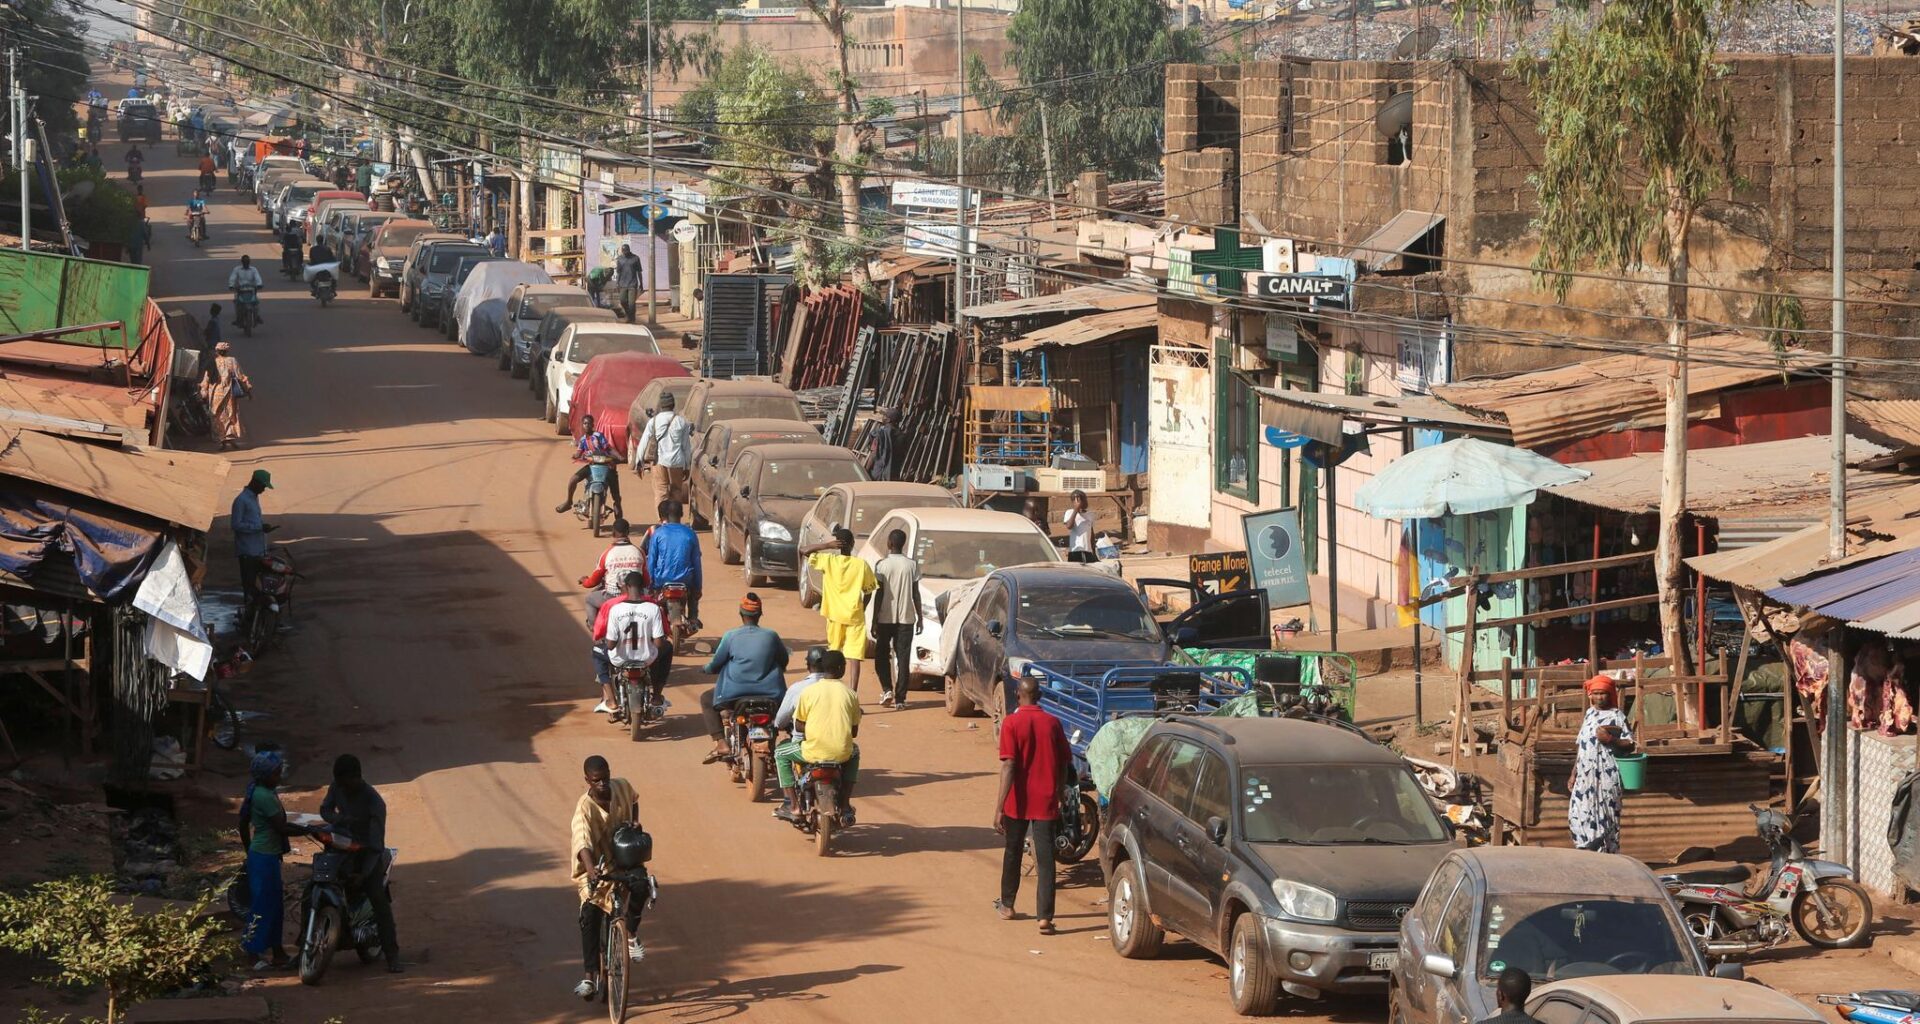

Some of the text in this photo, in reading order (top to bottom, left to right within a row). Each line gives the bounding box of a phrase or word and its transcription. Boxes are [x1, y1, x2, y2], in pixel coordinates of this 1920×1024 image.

[940, 188, 959, 197] MEDIC
[1268, 278, 1333, 294] CANAL+
[1191, 554, 1249, 576] Orange Money
[1263, 565, 1292, 577] telecel
[616, 611, 649, 621] CHAMPION
[623, 621, 639, 651] 1
